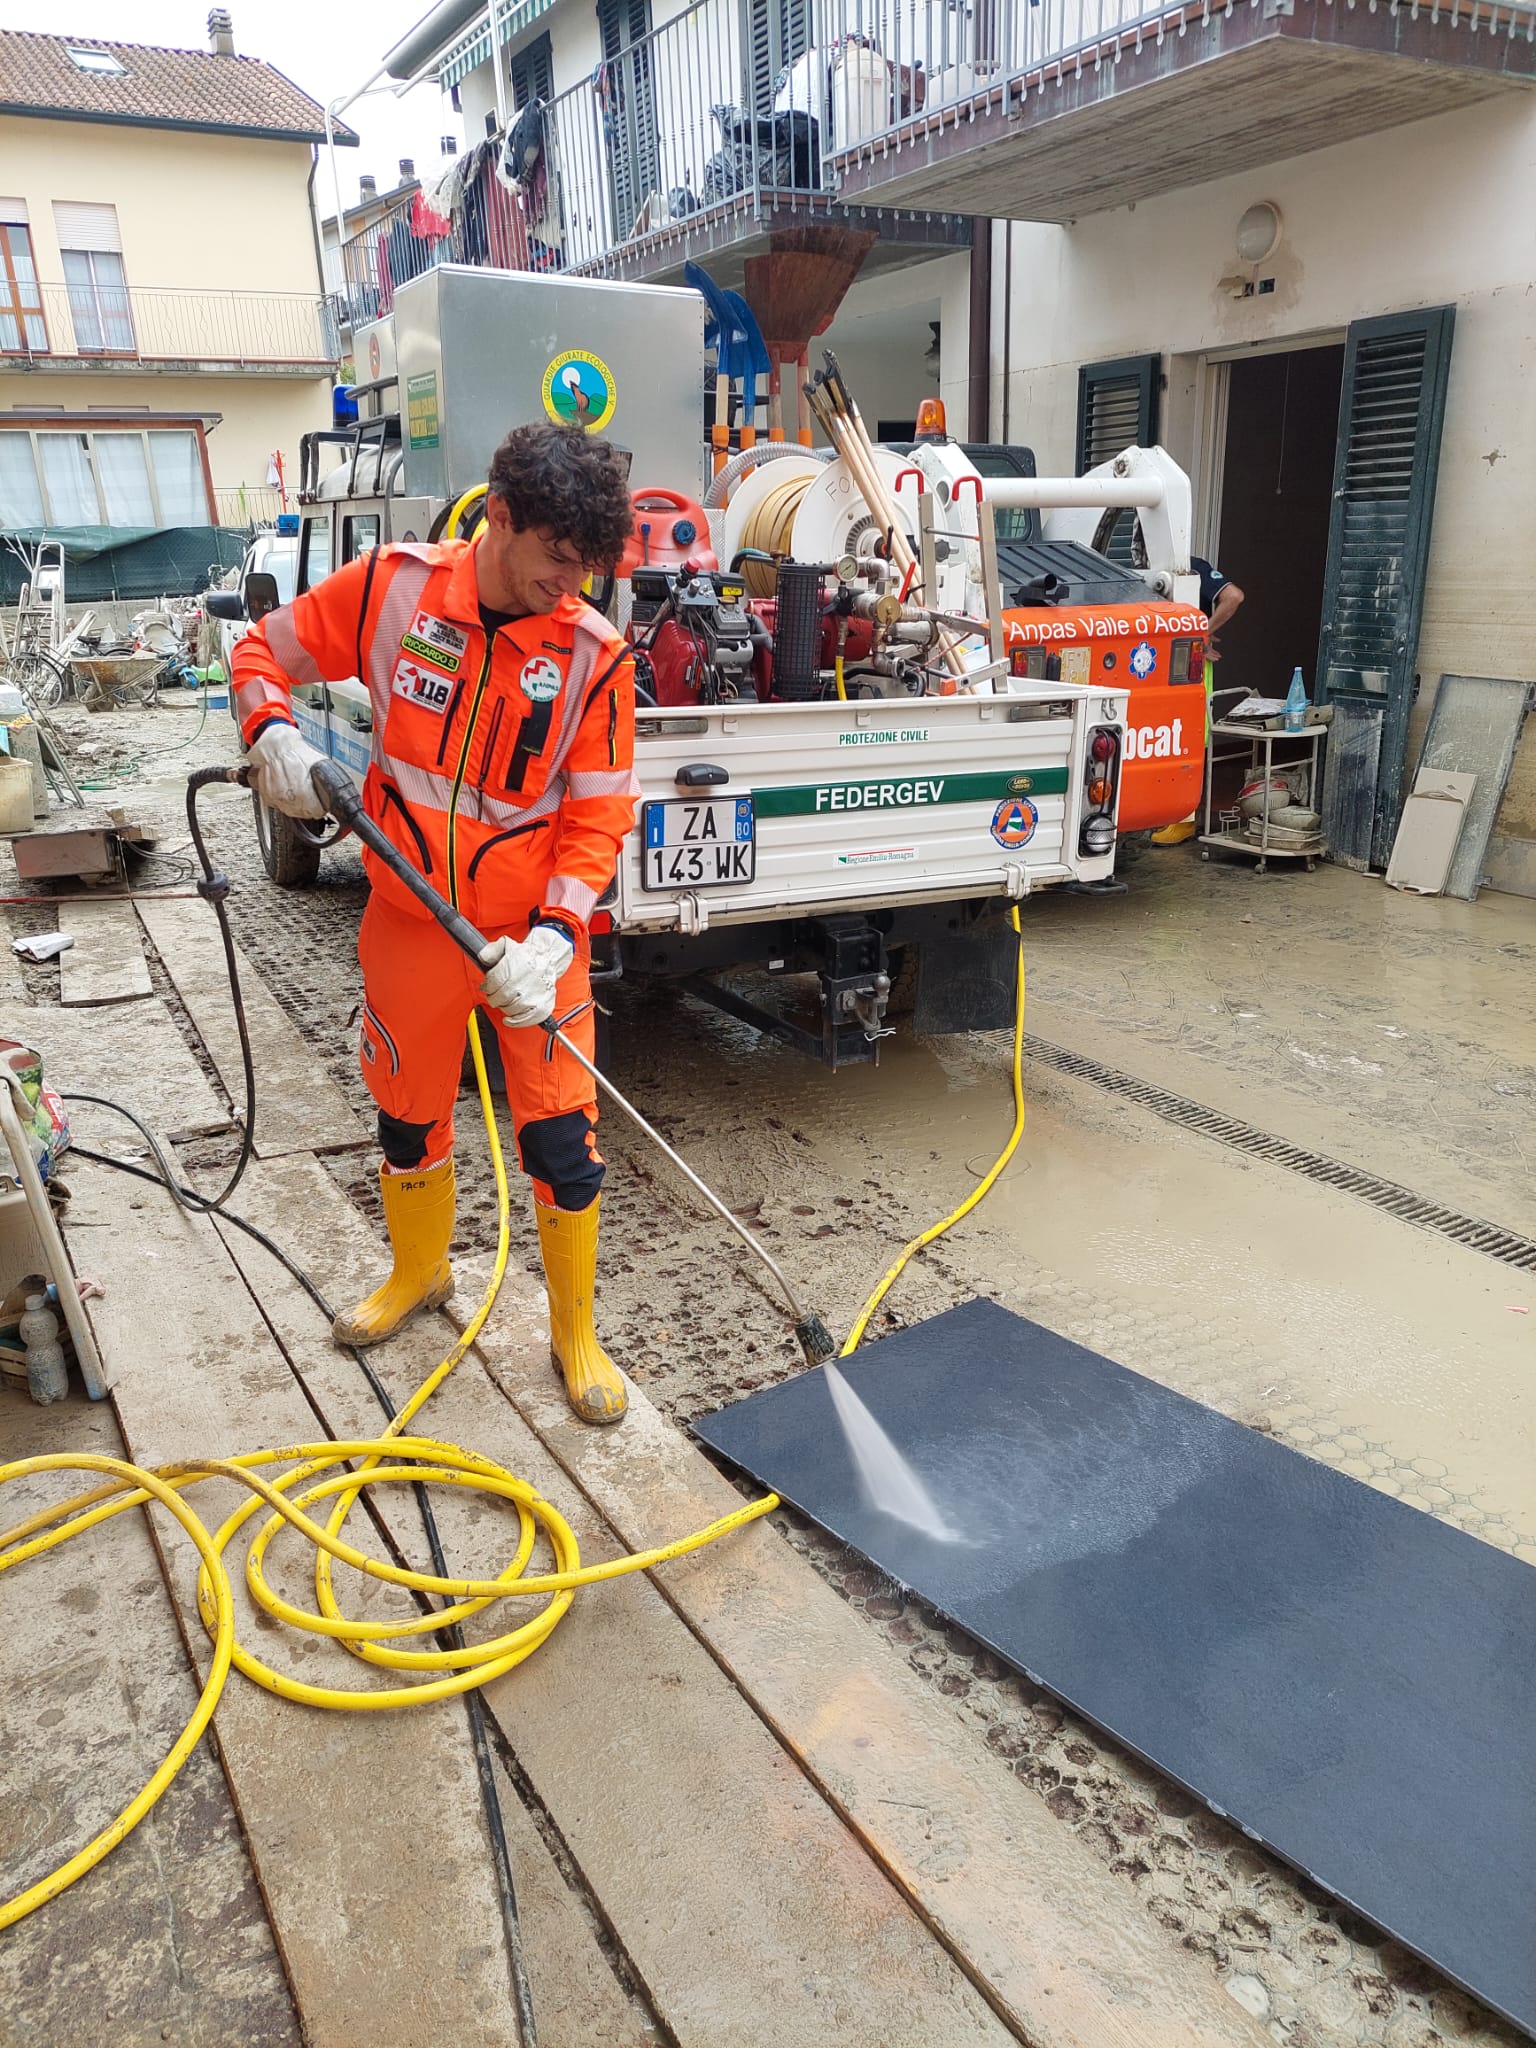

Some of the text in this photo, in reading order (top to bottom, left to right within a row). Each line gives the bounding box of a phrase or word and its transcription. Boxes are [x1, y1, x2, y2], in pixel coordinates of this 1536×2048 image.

[543, 365, 557, 400] GUARDIE
[555, 351, 583, 366] GIURATE
[587, 353, 616, 397] ECOLOGICHE
[825, 476, 855, 501] FO
[1009, 621, 1077, 645] Anpas
[1079, 616, 1129, 637] Valle
[404, 637, 447, 663] RICCARDO
[417, 677, 449, 705] 118
[839, 730, 929, 745] PROTEZIONE CIVILE
[1122, 718, 1182, 760] bcat
[815, 780, 945, 811] FEDERGEV
[683, 806, 717, 840] ZA
[736, 822, 750, 837] BO
[654, 844, 749, 883] 143 WK
